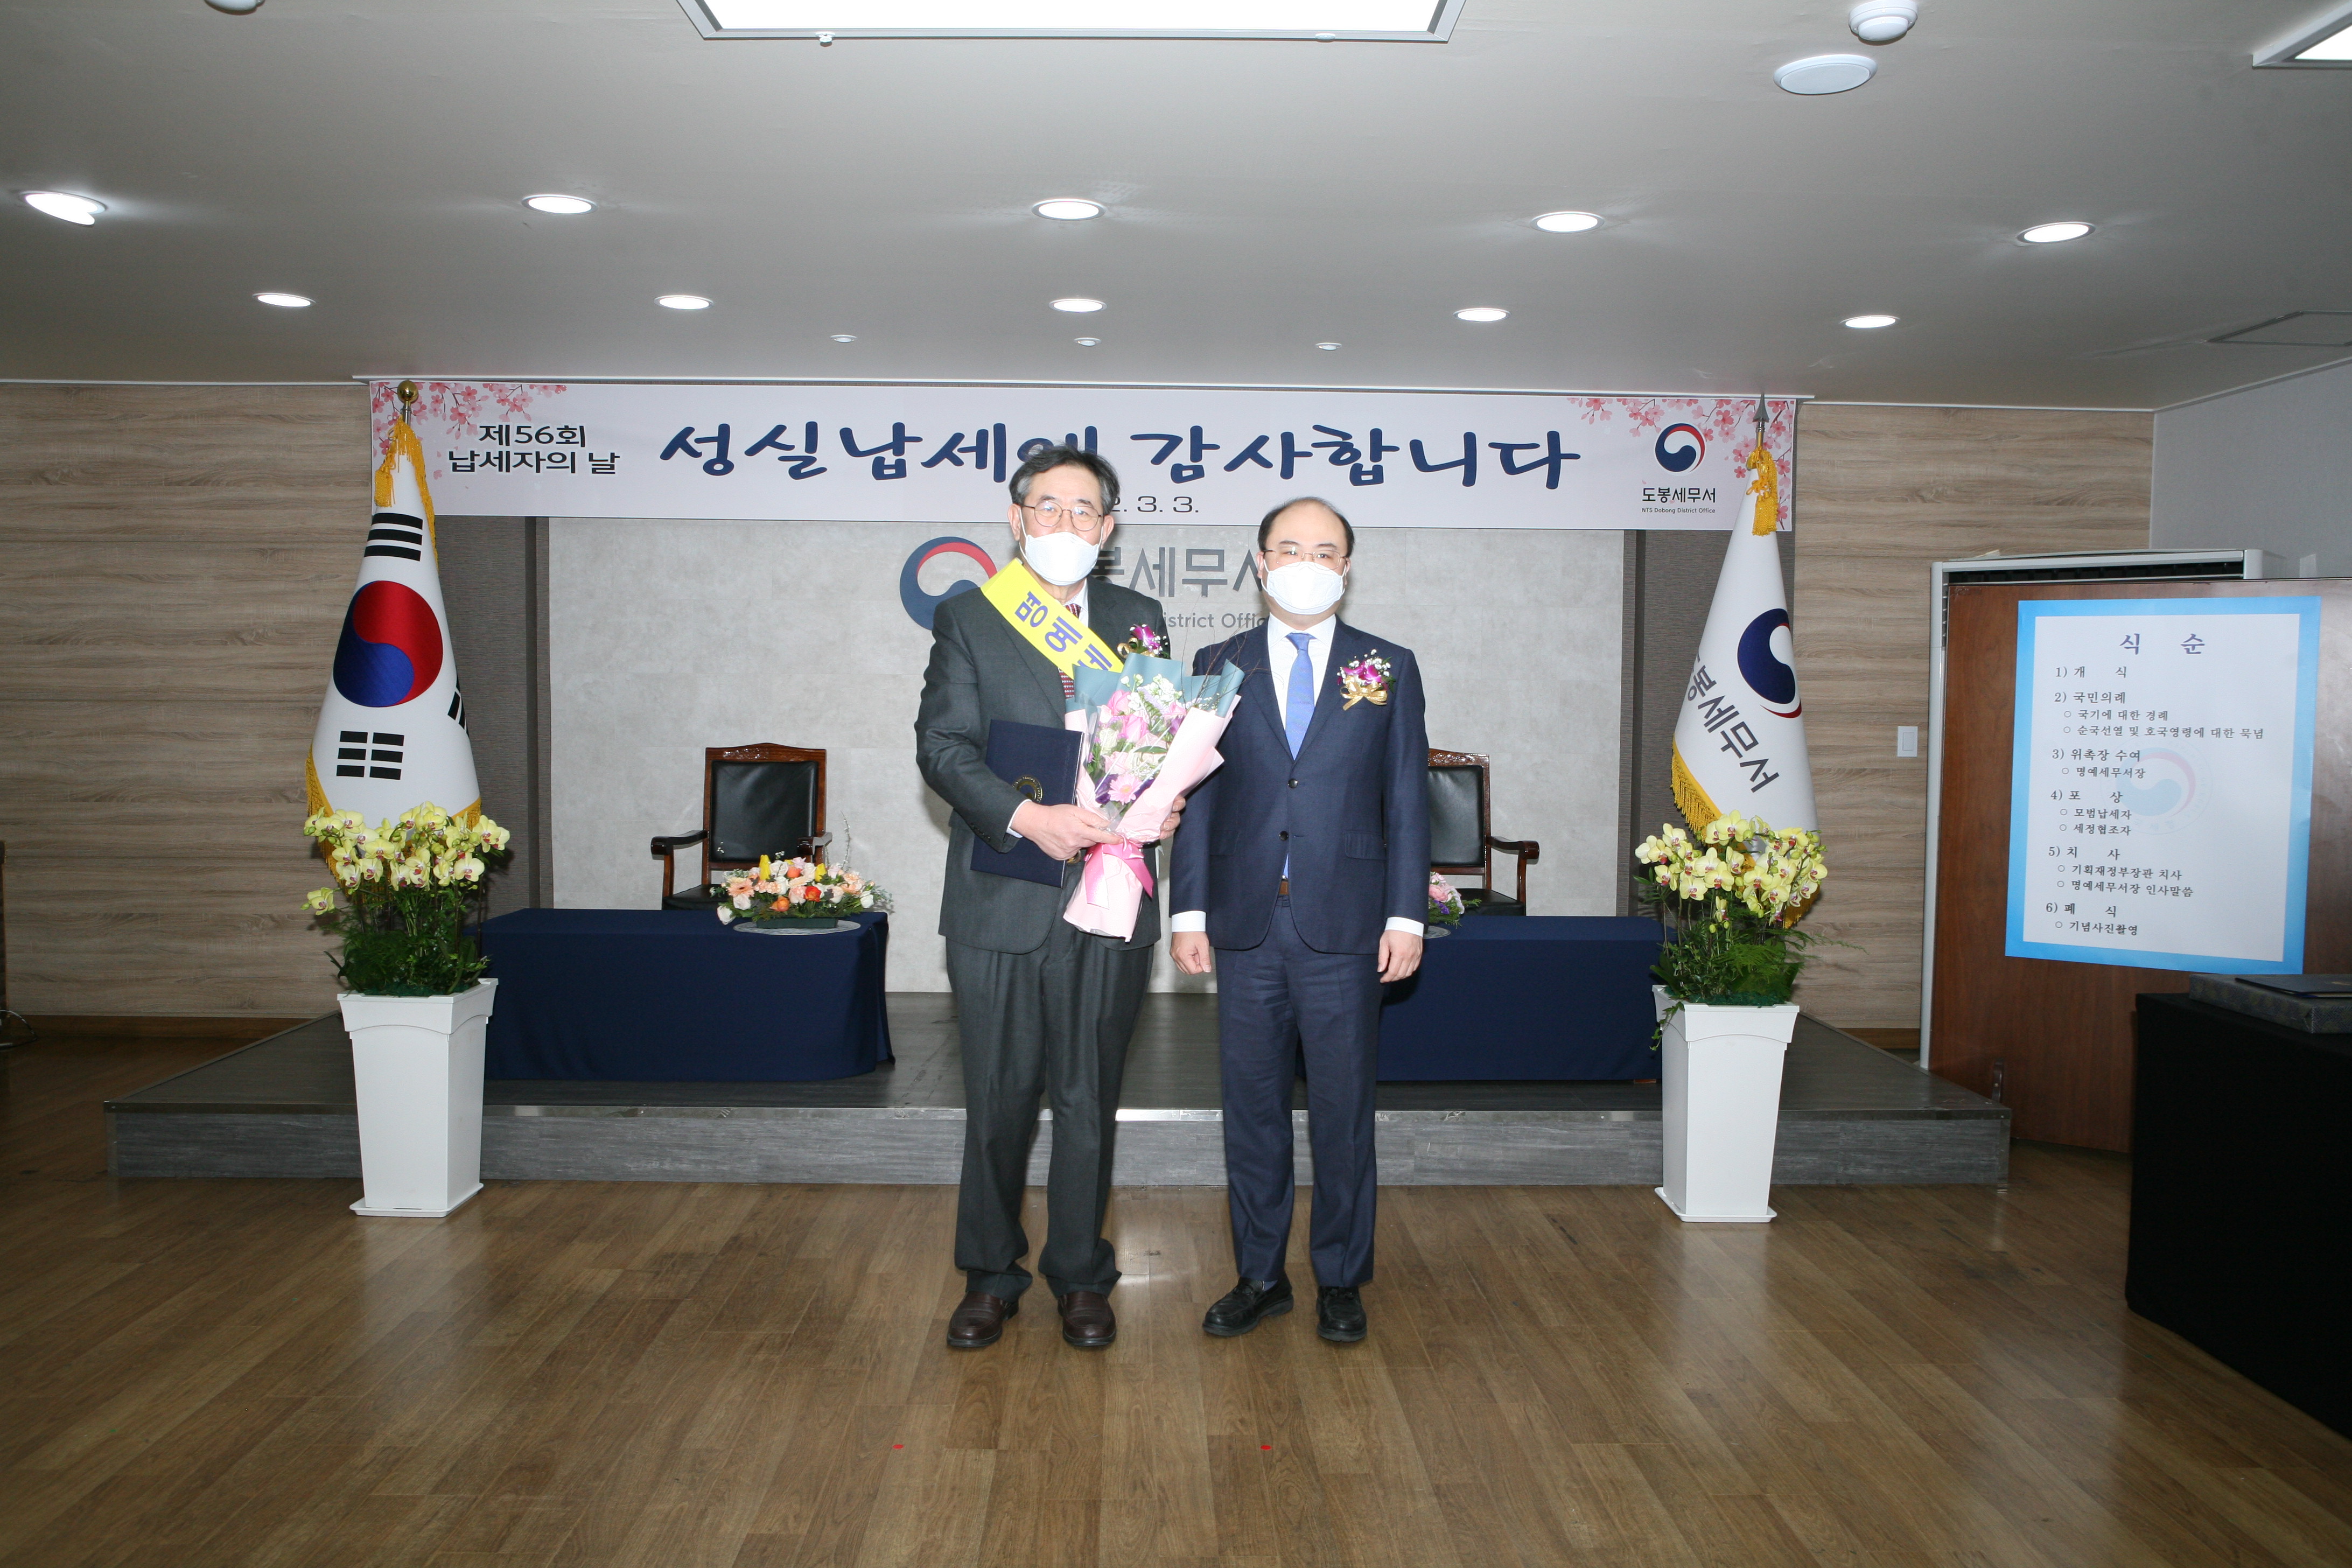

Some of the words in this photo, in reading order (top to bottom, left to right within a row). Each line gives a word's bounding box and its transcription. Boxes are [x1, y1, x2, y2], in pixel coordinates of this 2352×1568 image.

[479, 423, 586, 449] 제56회
[449, 451, 575, 473] 납세자의
[589, 452, 620, 474] 날
[1130, 425, 1580, 489] 감사합니다
[1642, 487, 1716, 503] 도봉세무서
[1164, 612, 1214, 628] istrict
[1221, 613, 1266, 628] Offic
[2119, 633, 2140, 655] 식
[2180, 634, 2205, 654] 순
[2056, 667, 2067, 678] 1)
[2074, 666, 2085, 678] 개
[2115, 667, 2126, 678] 식
[2054, 692, 2067, 703] 2)
[2073, 692, 2125, 704] 국민의례
[2078, 710, 2111, 720] 국기에
[2118, 710, 2140, 720] 대한
[2146, 710, 2168, 721] 경례
[1688, 654, 1780, 793] 봉세무서
[2077, 725, 2123, 736] 순국선열
[2129, 726, 2138, 737] 및
[2144, 727, 2204, 738] 호국영령에
[2211, 728, 2235, 738] 대한
[2239, 729, 2263, 739] 묵념
[2052, 748, 2064, 760] 3)
[2071, 748, 2110, 761] 위촉장
[2115, 750, 2140, 762] 수여
[2076, 766, 2146, 779] 명예세무서장
[2050, 789, 2062, 801] 4)
[2068, 791, 2081, 800] 포
[2110, 791, 2123, 803] 상
[2074, 808, 2132, 820] 모범납세자
[2073, 823, 2131, 836] 세정협조자
[2049, 846, 2060, 857] 5)
[2067, 846, 2077, 858] 치
[2107, 849, 2120, 860] 사
[2072, 864, 2154, 879] 기획재정부장관
[2159, 870, 2182, 880] 치사
[2071, 880, 2140, 894] 명예세무서장
[2146, 885, 2193, 897] 인사말씀
[2046, 902, 2057, 913] 6)
[2064, 903, 2075, 915] 폐
[2105, 906, 2116, 918] 식
[2069, 921, 2138, 936] 기념사진촬영
